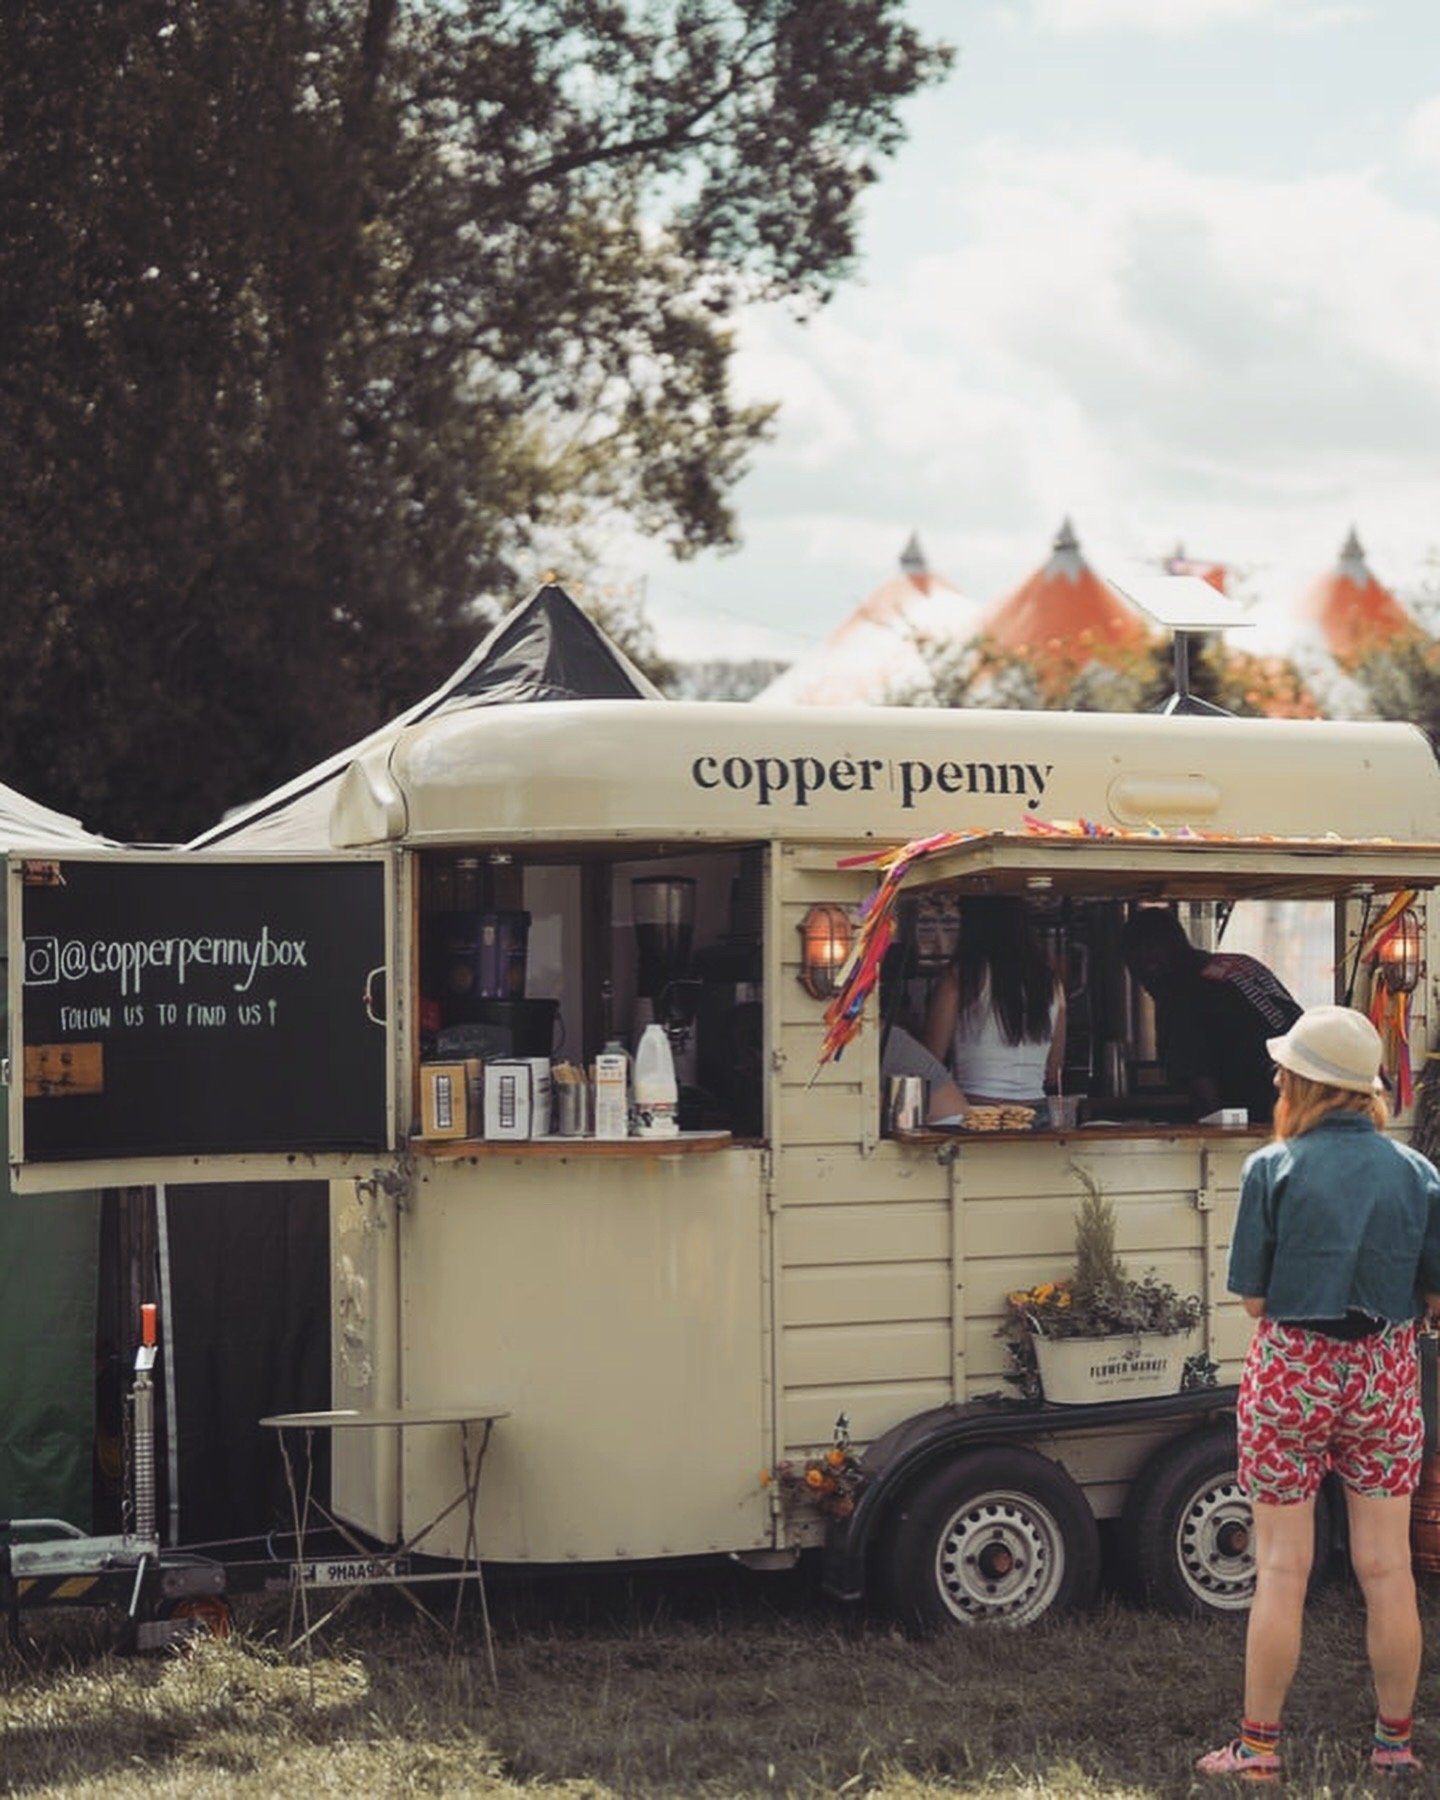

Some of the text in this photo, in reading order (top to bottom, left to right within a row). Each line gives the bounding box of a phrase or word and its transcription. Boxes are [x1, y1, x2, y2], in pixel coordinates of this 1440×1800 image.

[692, 757, 1053, 809] copper penny
[61, 926, 308, 996] @copperpennybox
[61, 1003, 111, 1031] FOLLOW
[123, 1004, 145, 1027] US
[157, 1003, 177, 1027] TO
[187, 1003, 227, 1027] FIND
[1090, 1358, 1167, 1378] FLOWER MARKET
